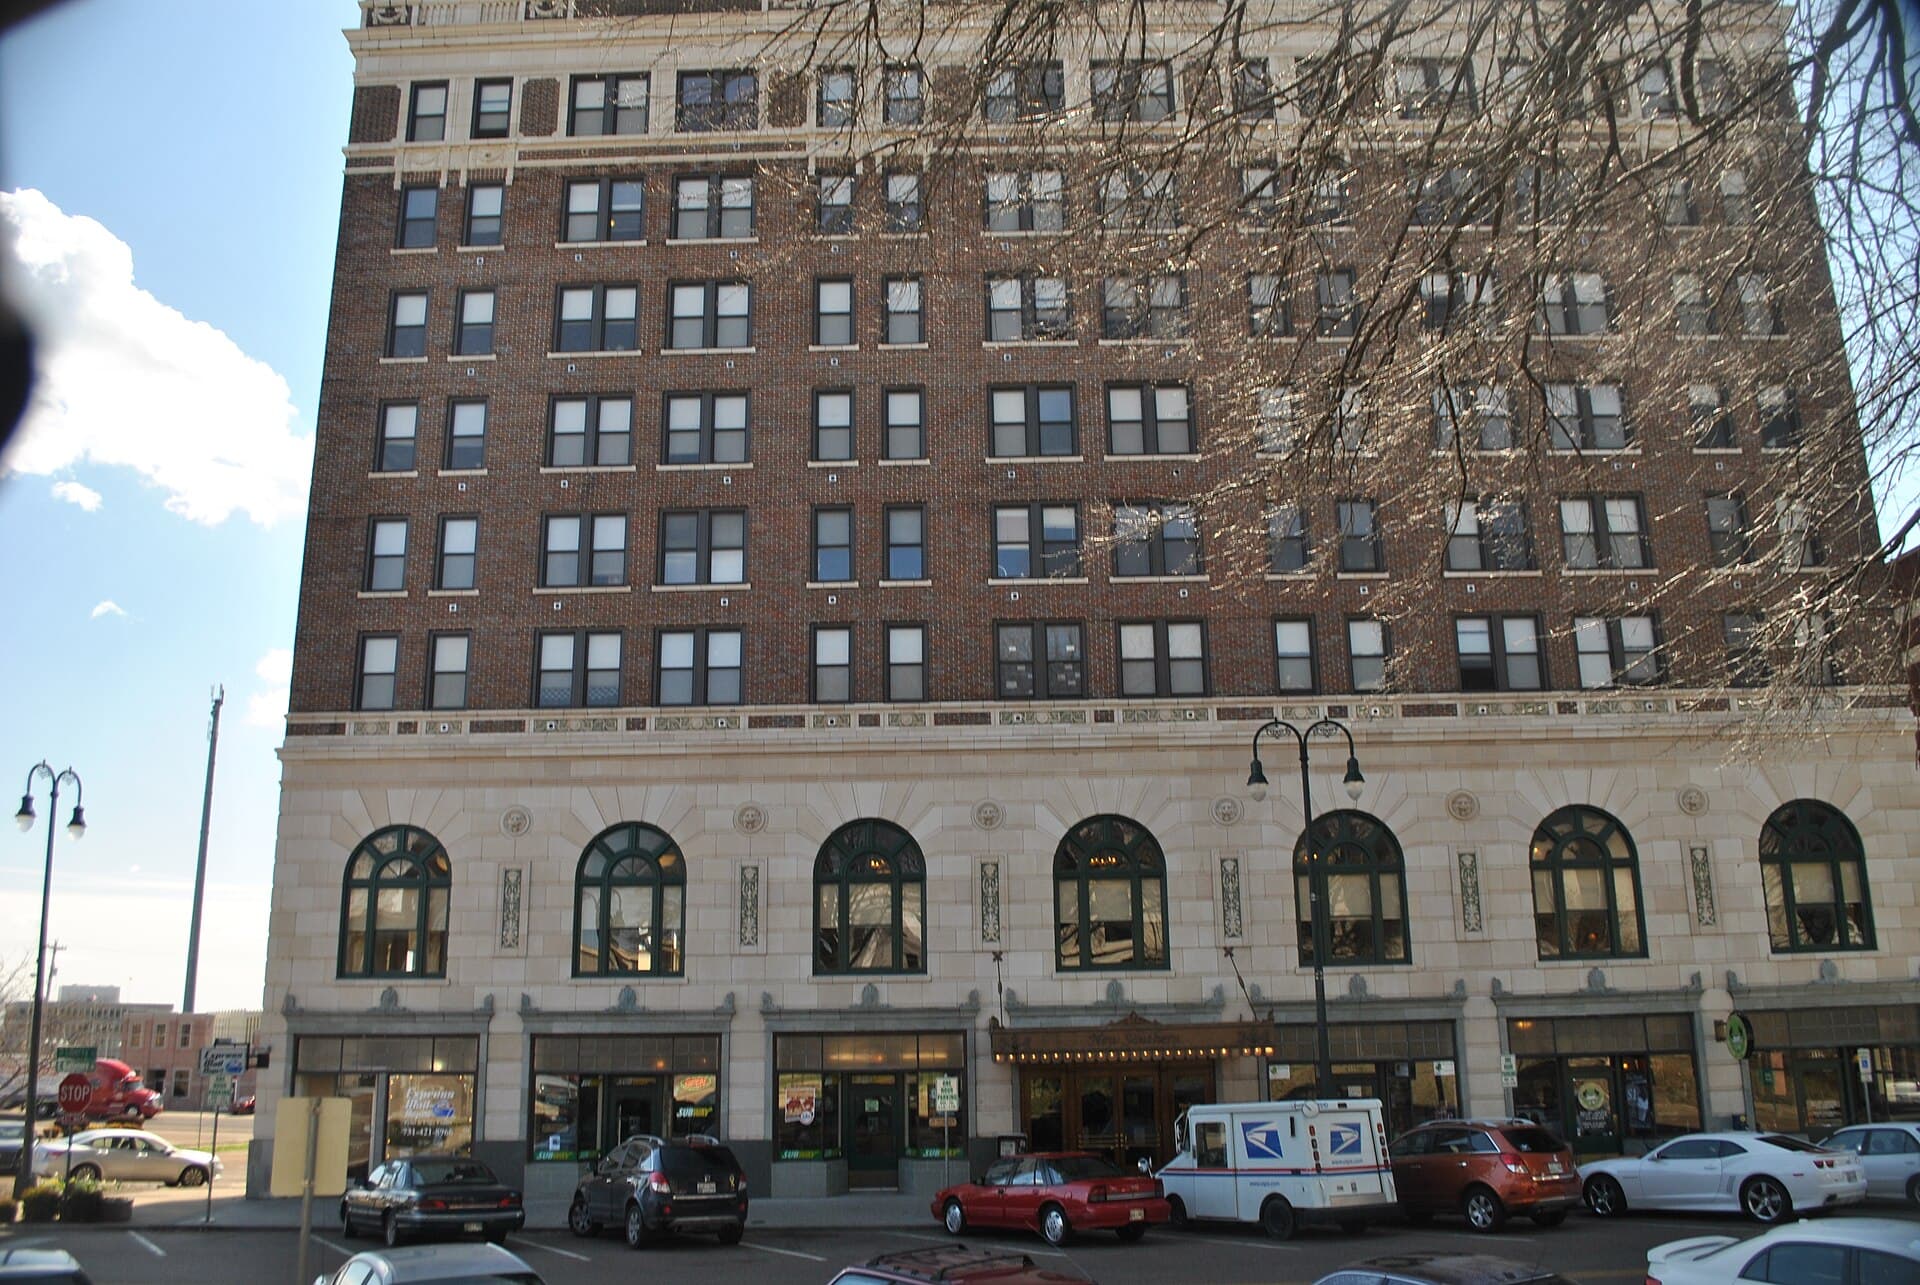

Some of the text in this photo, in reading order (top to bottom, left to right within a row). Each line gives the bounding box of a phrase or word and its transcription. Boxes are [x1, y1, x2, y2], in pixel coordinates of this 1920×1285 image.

[204, 1050, 243, 1060] Express
[60, 1085, 90, 1102] STOP
[406, 1088, 455, 1100] Express
[676, 1106, 713, 1118] SUBWAY
[536, 1152, 571, 1160] SUBWAY
[782, 1149, 820, 1159] SUBWAY
[923, 1149, 961, 1157] SUBWAY
